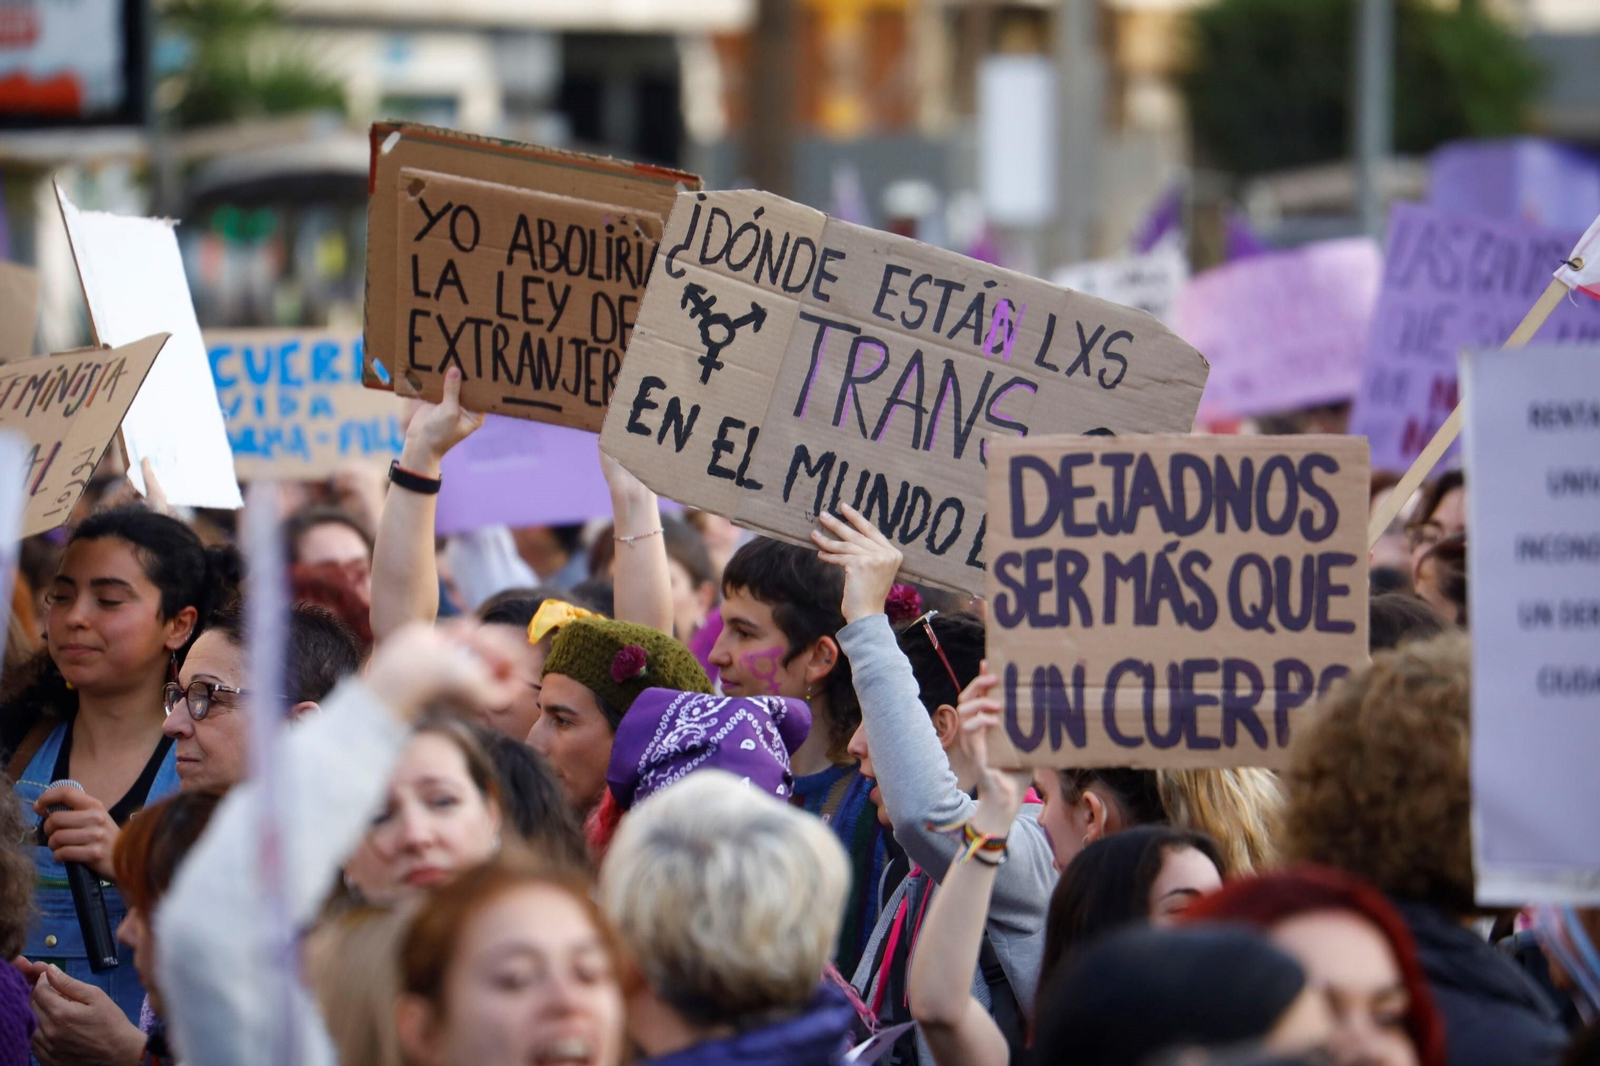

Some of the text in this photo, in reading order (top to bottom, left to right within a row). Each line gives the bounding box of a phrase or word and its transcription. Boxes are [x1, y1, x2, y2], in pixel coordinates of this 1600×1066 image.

[413, 197, 480, 252] YO
[412, 254, 638, 352] LA LEY DE
[665, 192, 846, 302] ¿DÓNDE
[1034, 313, 1133, 390] LXS
[793, 311, 1038, 466] TRANS
[625, 376, 700, 453] EN
[706, 416, 763, 490] EL
[783, 443, 966, 556] MUNDO
[1009, 452, 1341, 543] DEJADNOS
[993, 541, 1358, 635] SER MÁS QUE
[1004, 661, 1088, 753] UN
